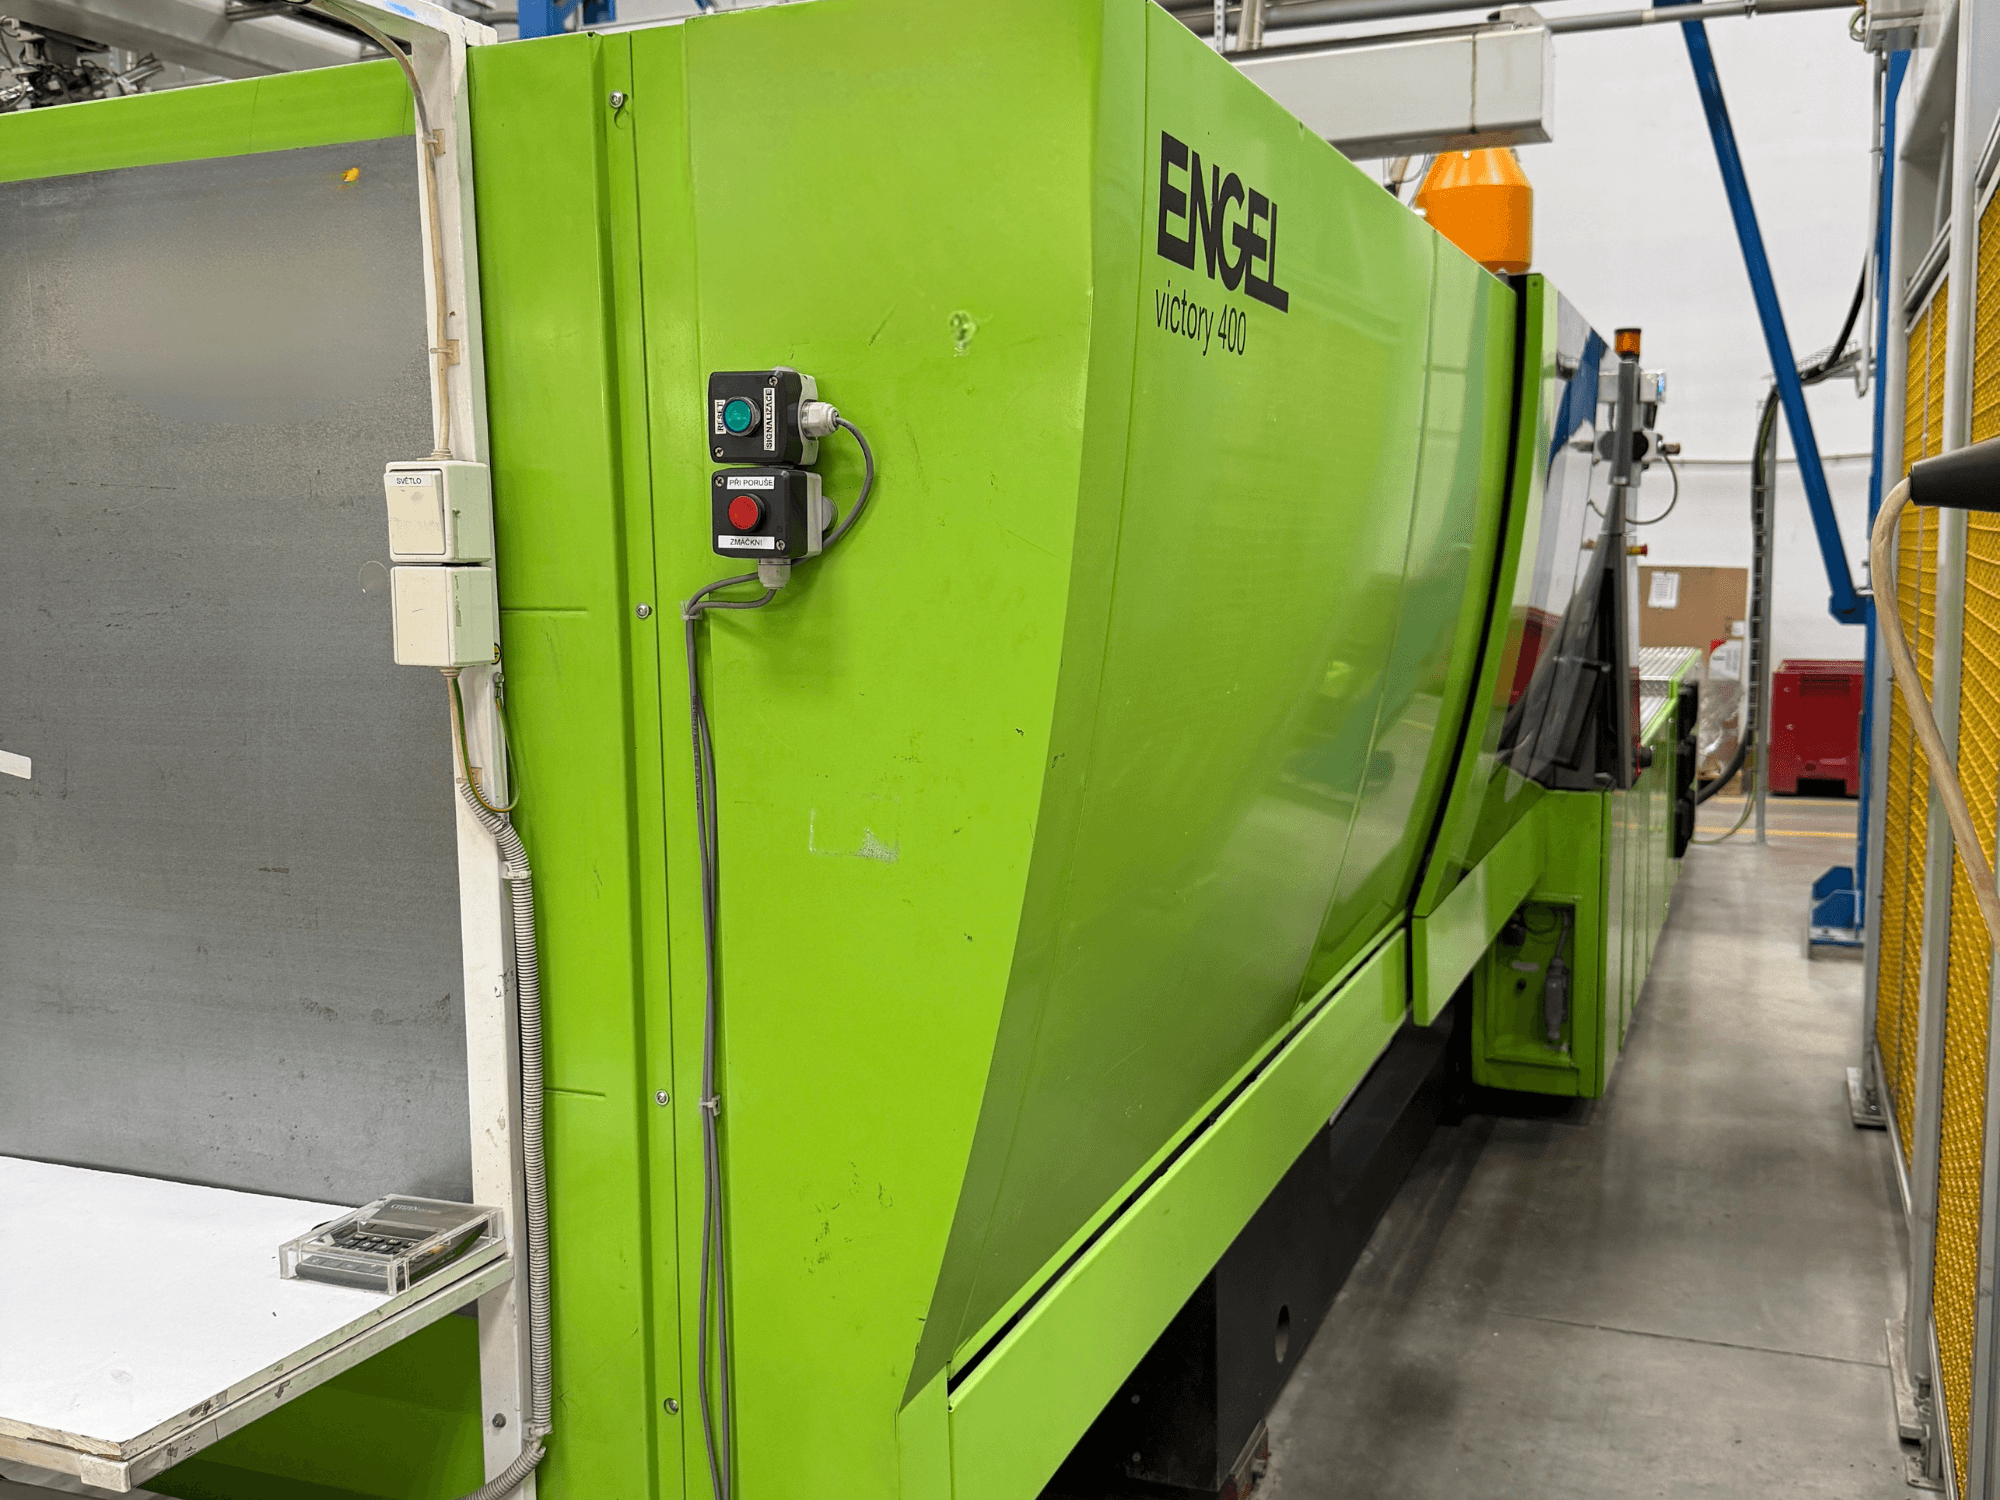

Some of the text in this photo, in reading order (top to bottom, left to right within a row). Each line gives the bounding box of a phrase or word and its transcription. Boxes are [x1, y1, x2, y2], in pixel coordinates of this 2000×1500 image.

[1157, 130, 1289, 314] ENGEL
[1155, 279, 1247, 356] victory 400
[765, 389, 773, 449] SIGNALIZACE
[729, 478, 774, 487] PŘI PORUŠE
